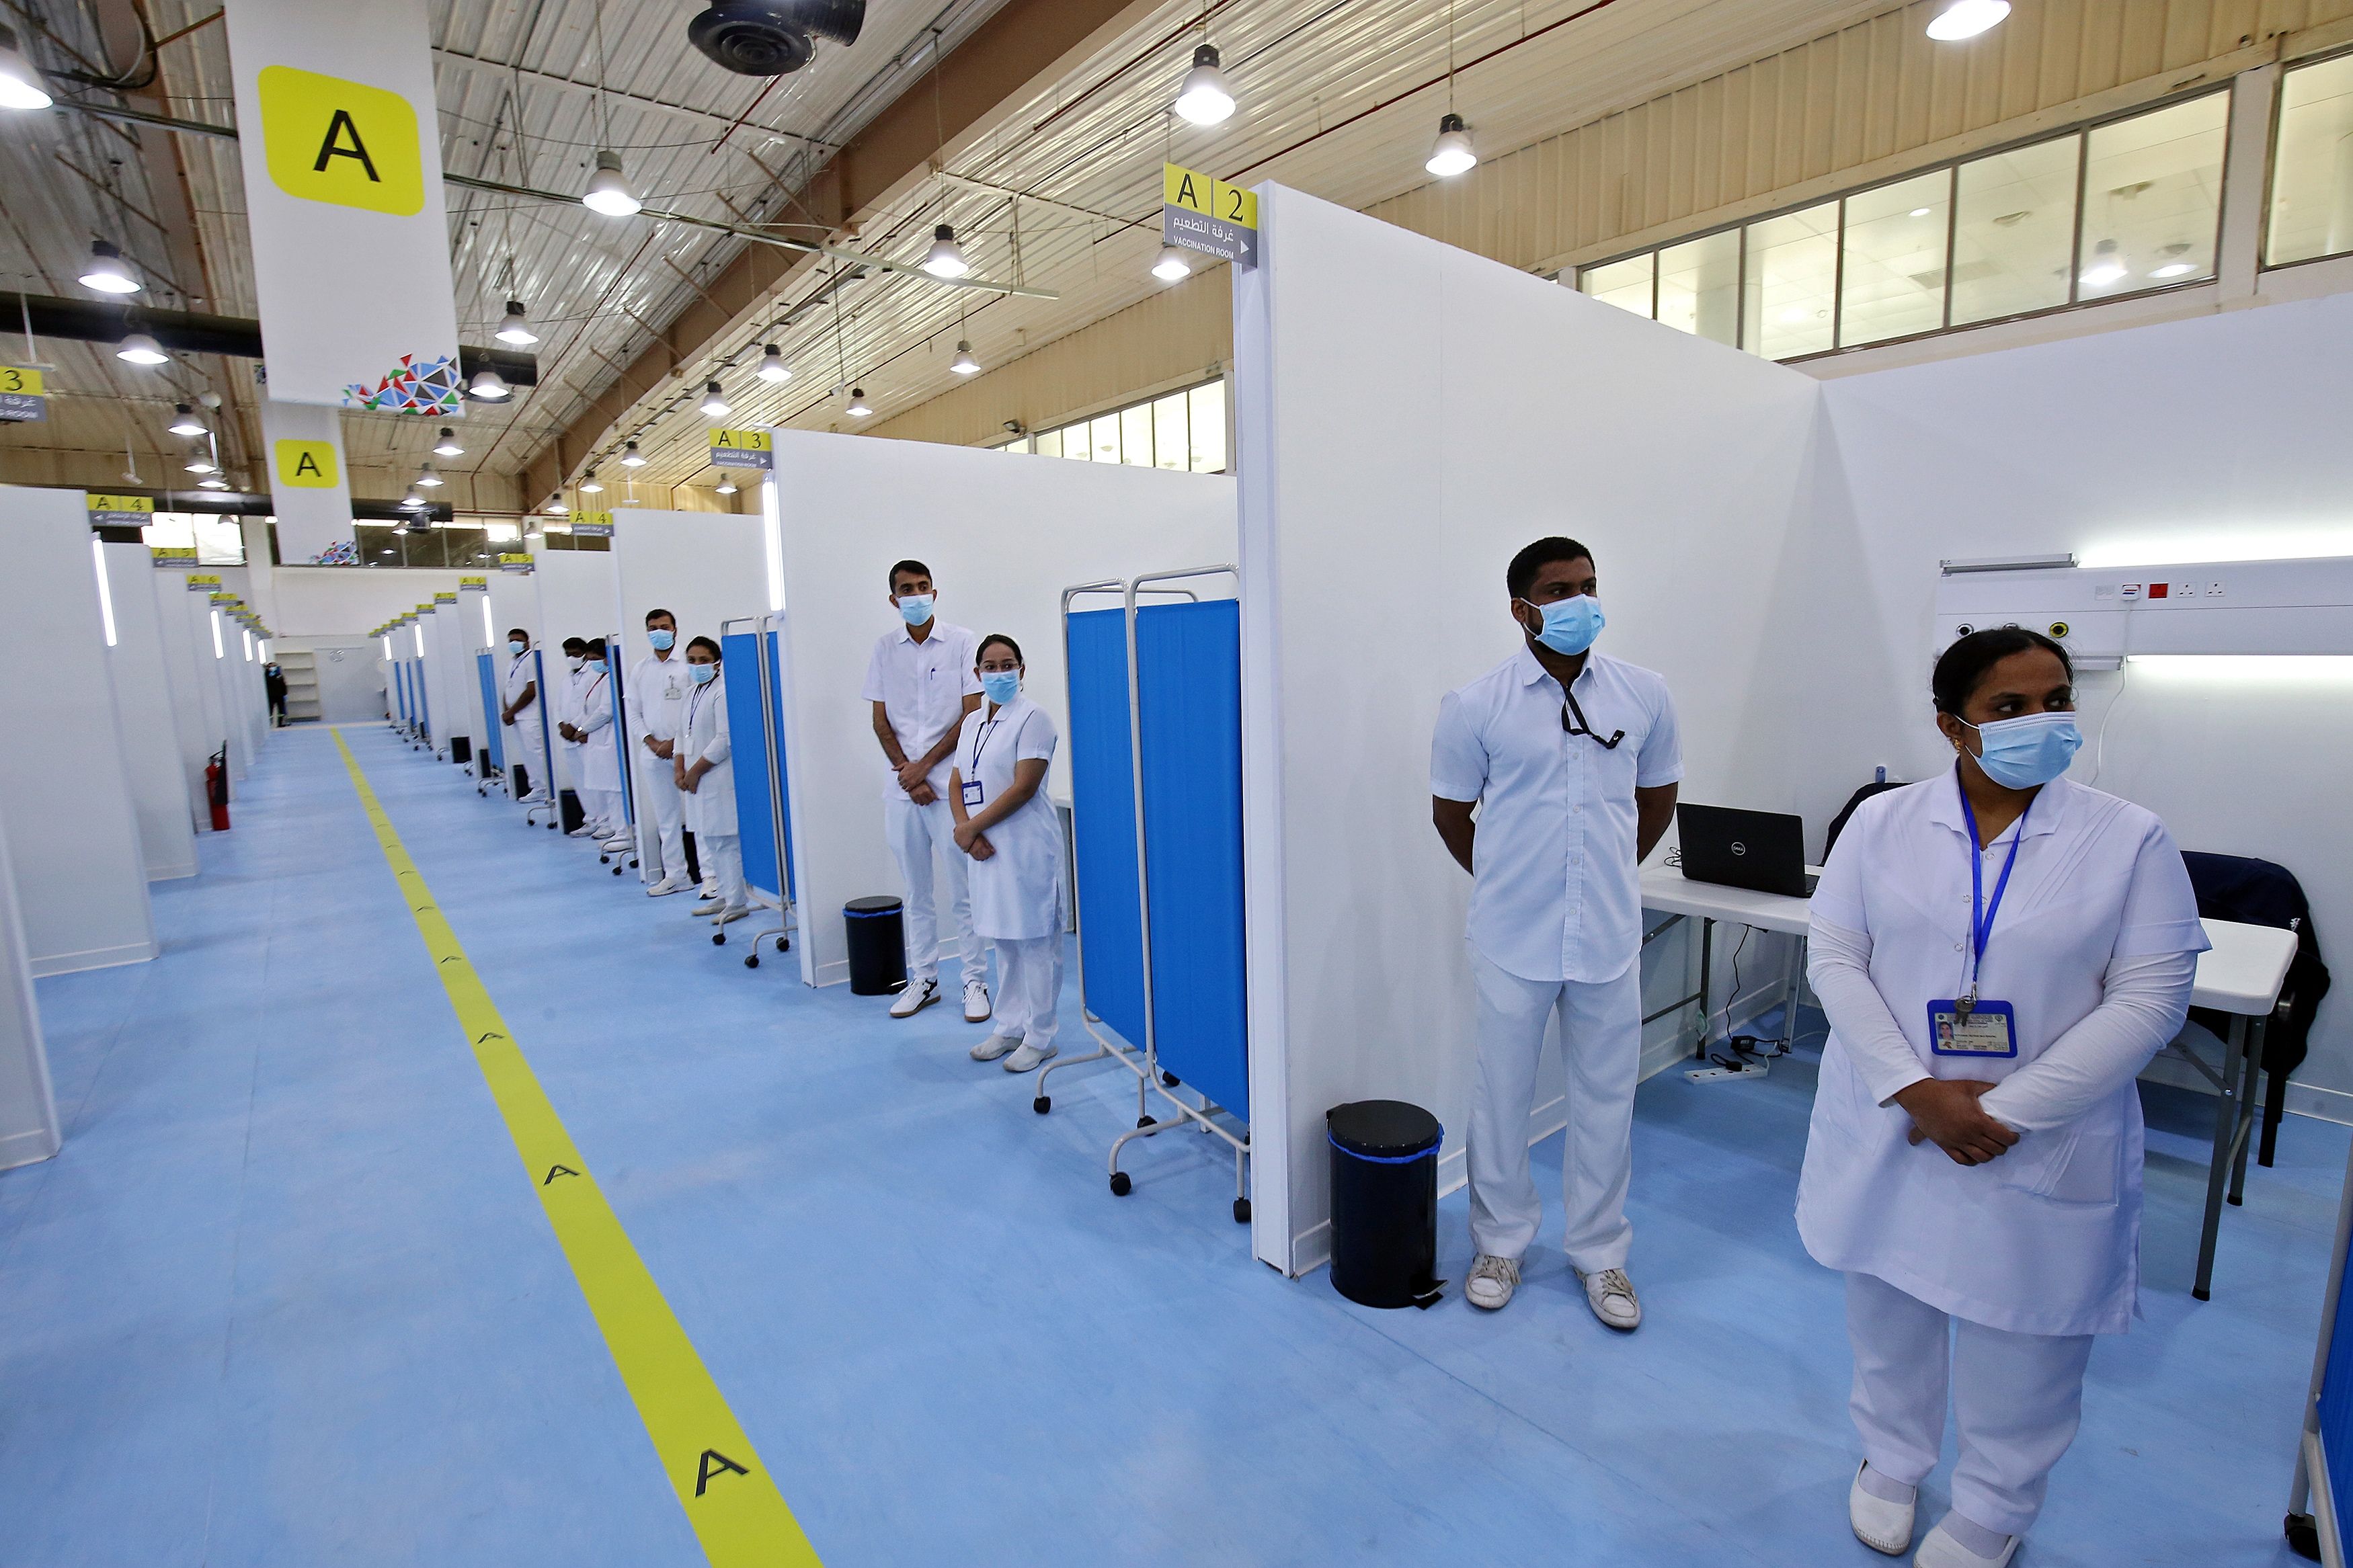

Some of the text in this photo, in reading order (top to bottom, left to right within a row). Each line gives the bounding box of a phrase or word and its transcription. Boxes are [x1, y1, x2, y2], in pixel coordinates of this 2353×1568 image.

[313, 108, 381, 183] A
[1176, 173, 1244, 222] A 2
[1173, 216, 1234, 242] غرفة التطعيم
[1174, 236, 1234, 259] VACCINATION ROOM
[3, 370, 22, 390] 3
[717, 430, 761, 449] A 3
[295, 451, 323, 478] A
[95, 496, 144, 511] A 4
[575, 511, 606, 524] A 4
[504, 554, 512, 563] A
[477, 1031, 505, 1044] A
[543, 1163, 582, 1186] A
[694, 1447, 750, 1499] A
